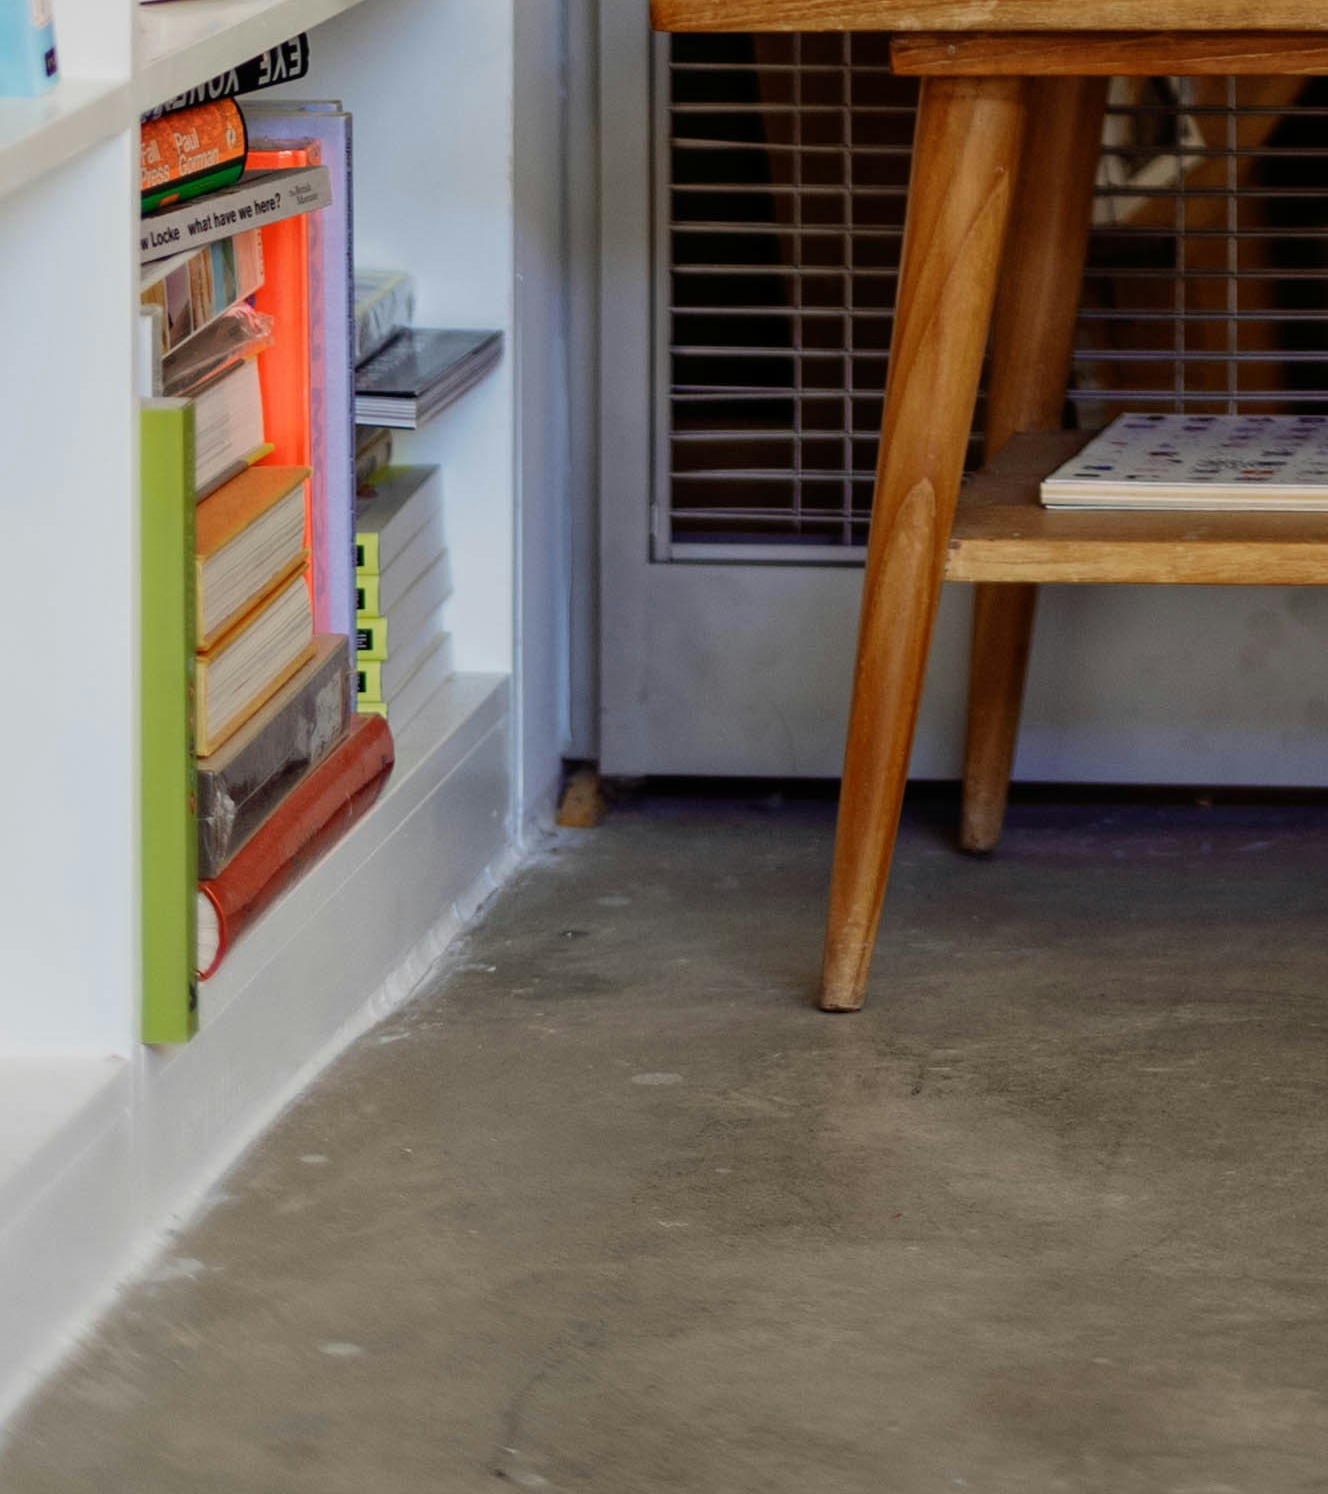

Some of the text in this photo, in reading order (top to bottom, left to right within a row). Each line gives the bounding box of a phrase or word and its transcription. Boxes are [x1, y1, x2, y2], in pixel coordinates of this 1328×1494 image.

[258, 37, 301, 85] EYE
[174, 127, 200, 155] Paul
[178, 147, 220, 178] Gorman
[151, 225, 181, 248] Locke
[188, 218, 212, 237] what
[214, 211, 237, 229] have
[238, 205, 254, 220] we
[254, 192, 281, 216] here?
